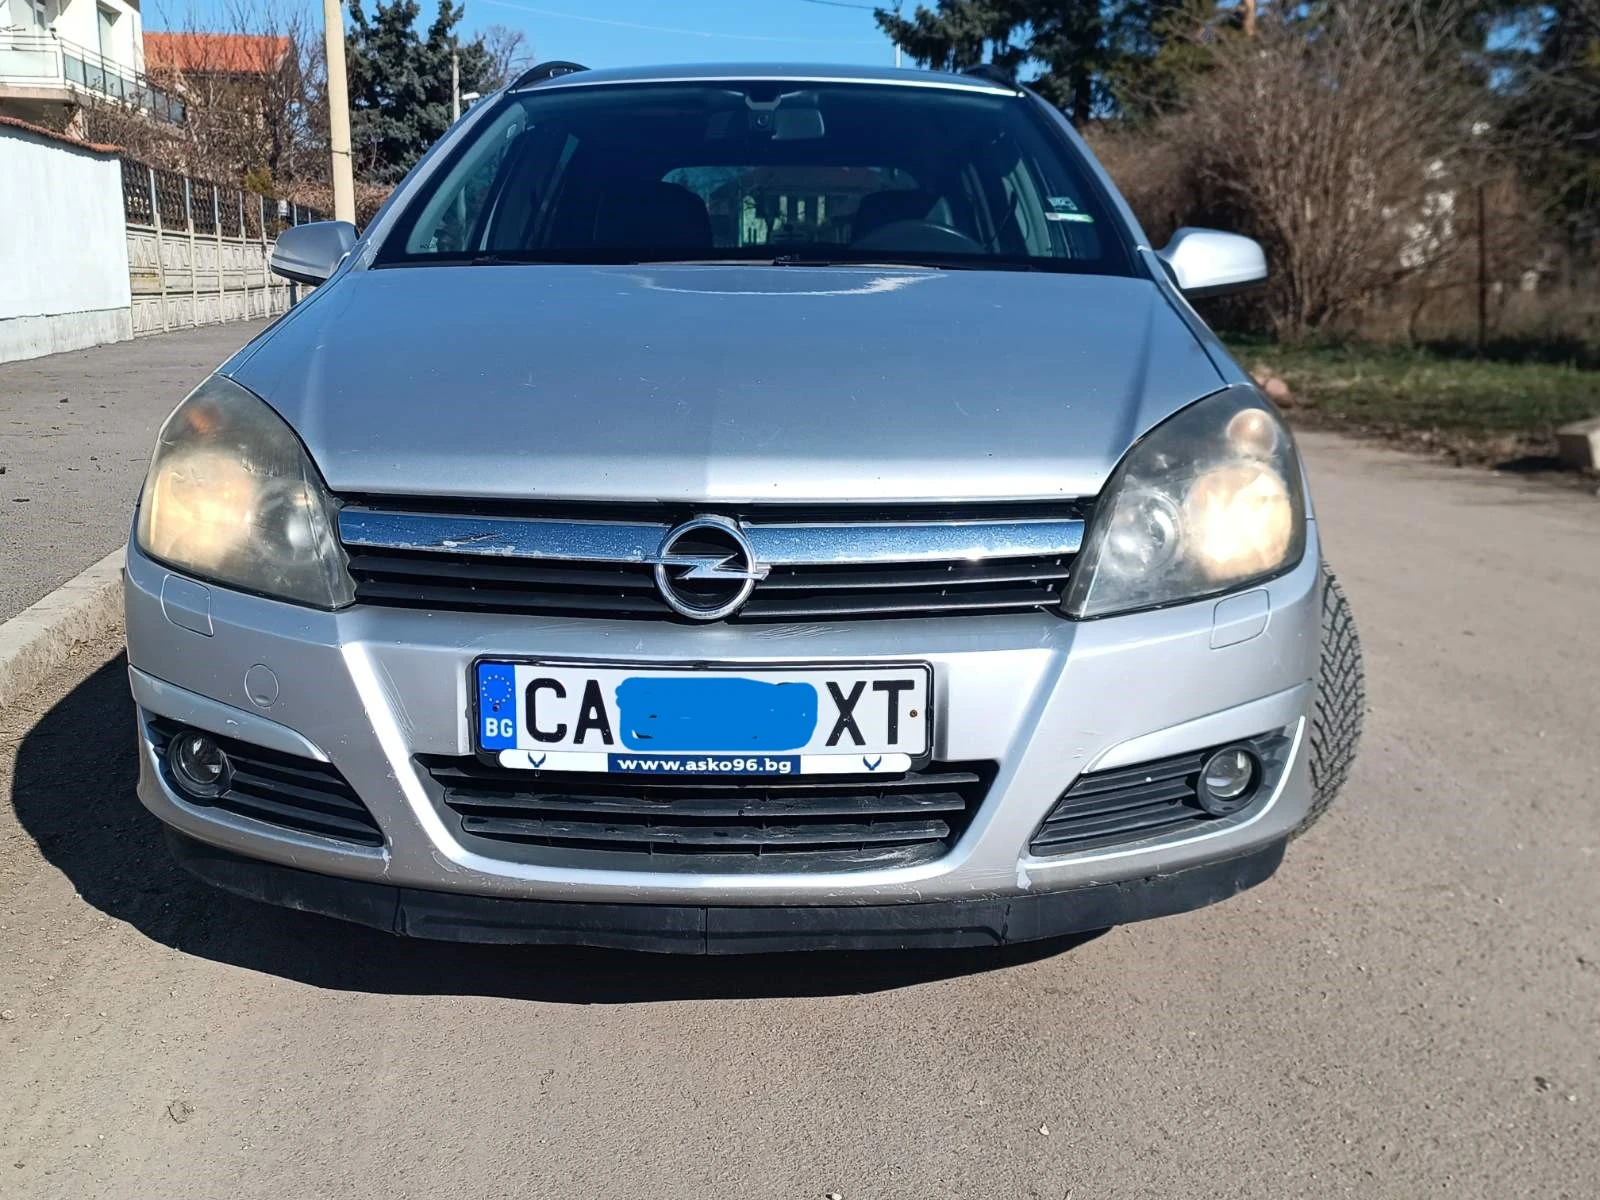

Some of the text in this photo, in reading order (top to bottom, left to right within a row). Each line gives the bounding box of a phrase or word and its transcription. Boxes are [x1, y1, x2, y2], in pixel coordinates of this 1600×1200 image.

[525, 678, 614, 745] CA
[825, 680, 915, 746] XT
[485, 717, 513, 738] BG
[617, 757, 792, 774] www.asko96.bg
